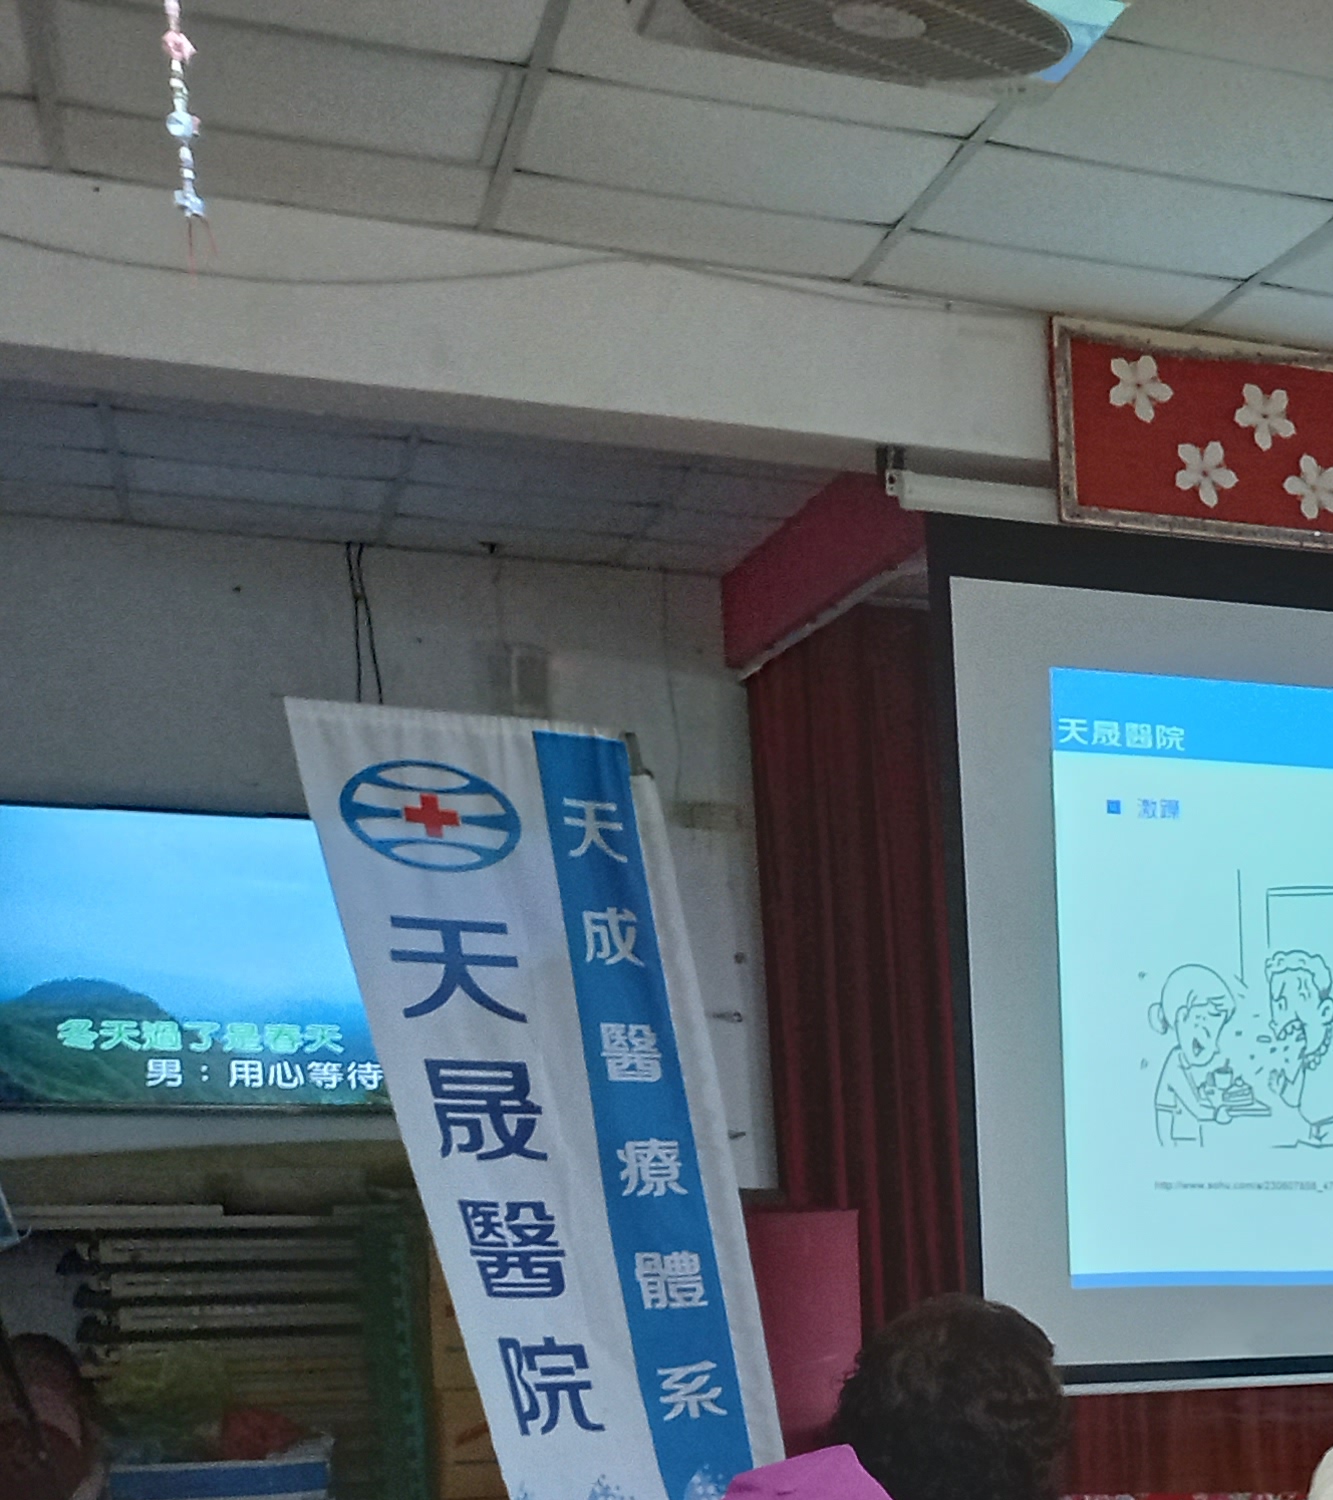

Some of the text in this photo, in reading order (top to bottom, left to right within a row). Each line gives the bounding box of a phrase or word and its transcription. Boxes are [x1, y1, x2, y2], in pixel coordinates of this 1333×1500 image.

[1058, 718, 1185, 751] 天晟醫院
[388, 914, 605, 1436] 天晟醫院
[562, 798, 728, 1422] 天成醫療體系
